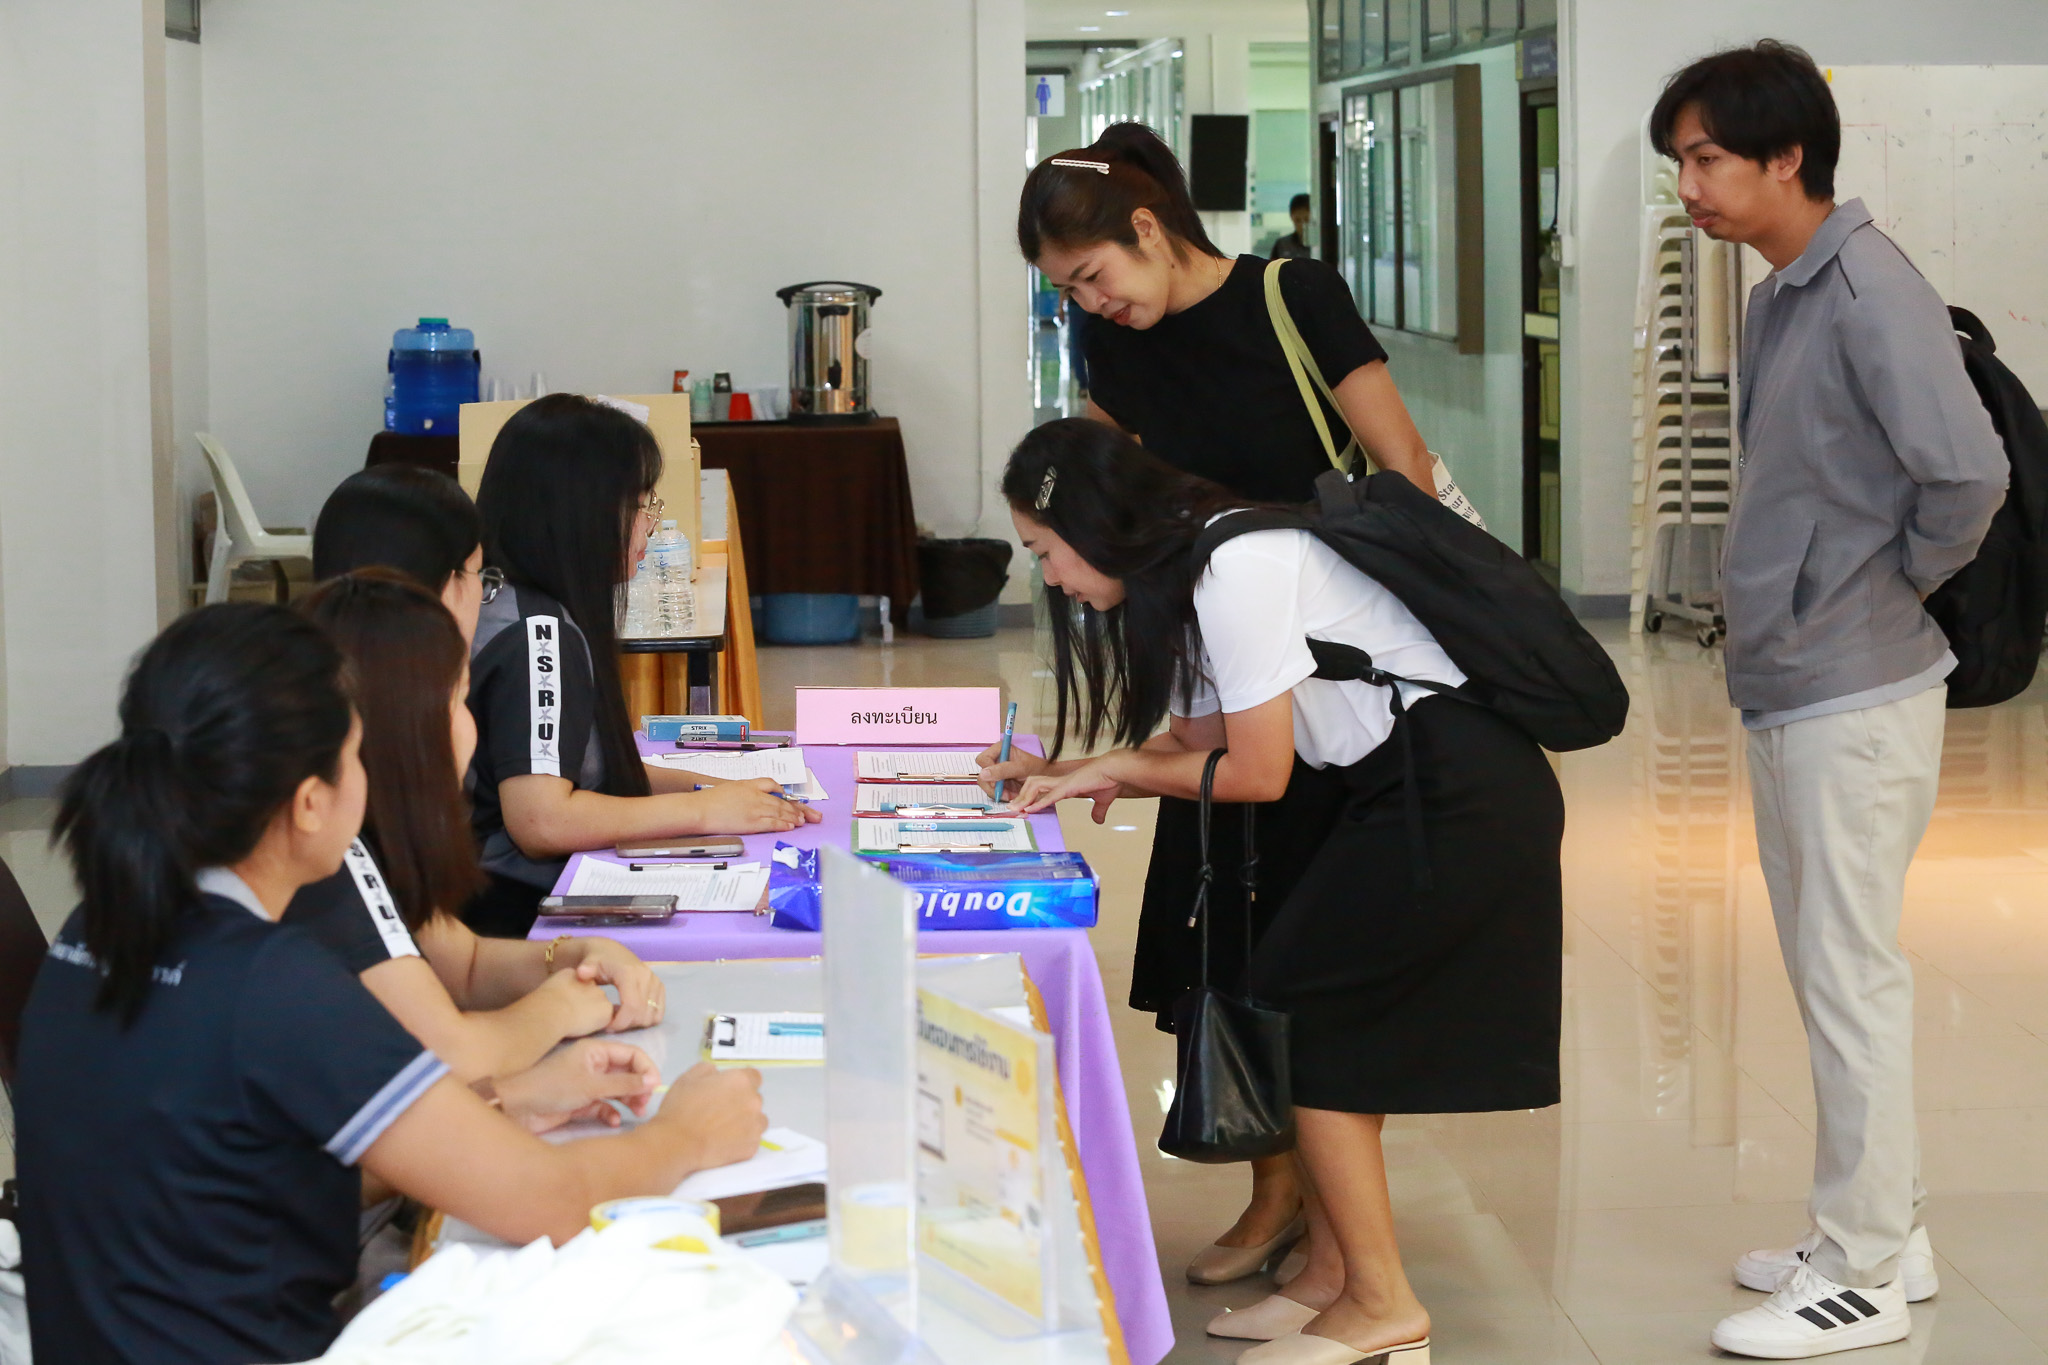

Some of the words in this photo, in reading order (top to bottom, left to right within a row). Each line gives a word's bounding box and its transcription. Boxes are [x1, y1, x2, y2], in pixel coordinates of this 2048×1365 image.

[535, 624, 555, 741] NSRU
[851, 706, 938, 725] ลงทะเบียน
